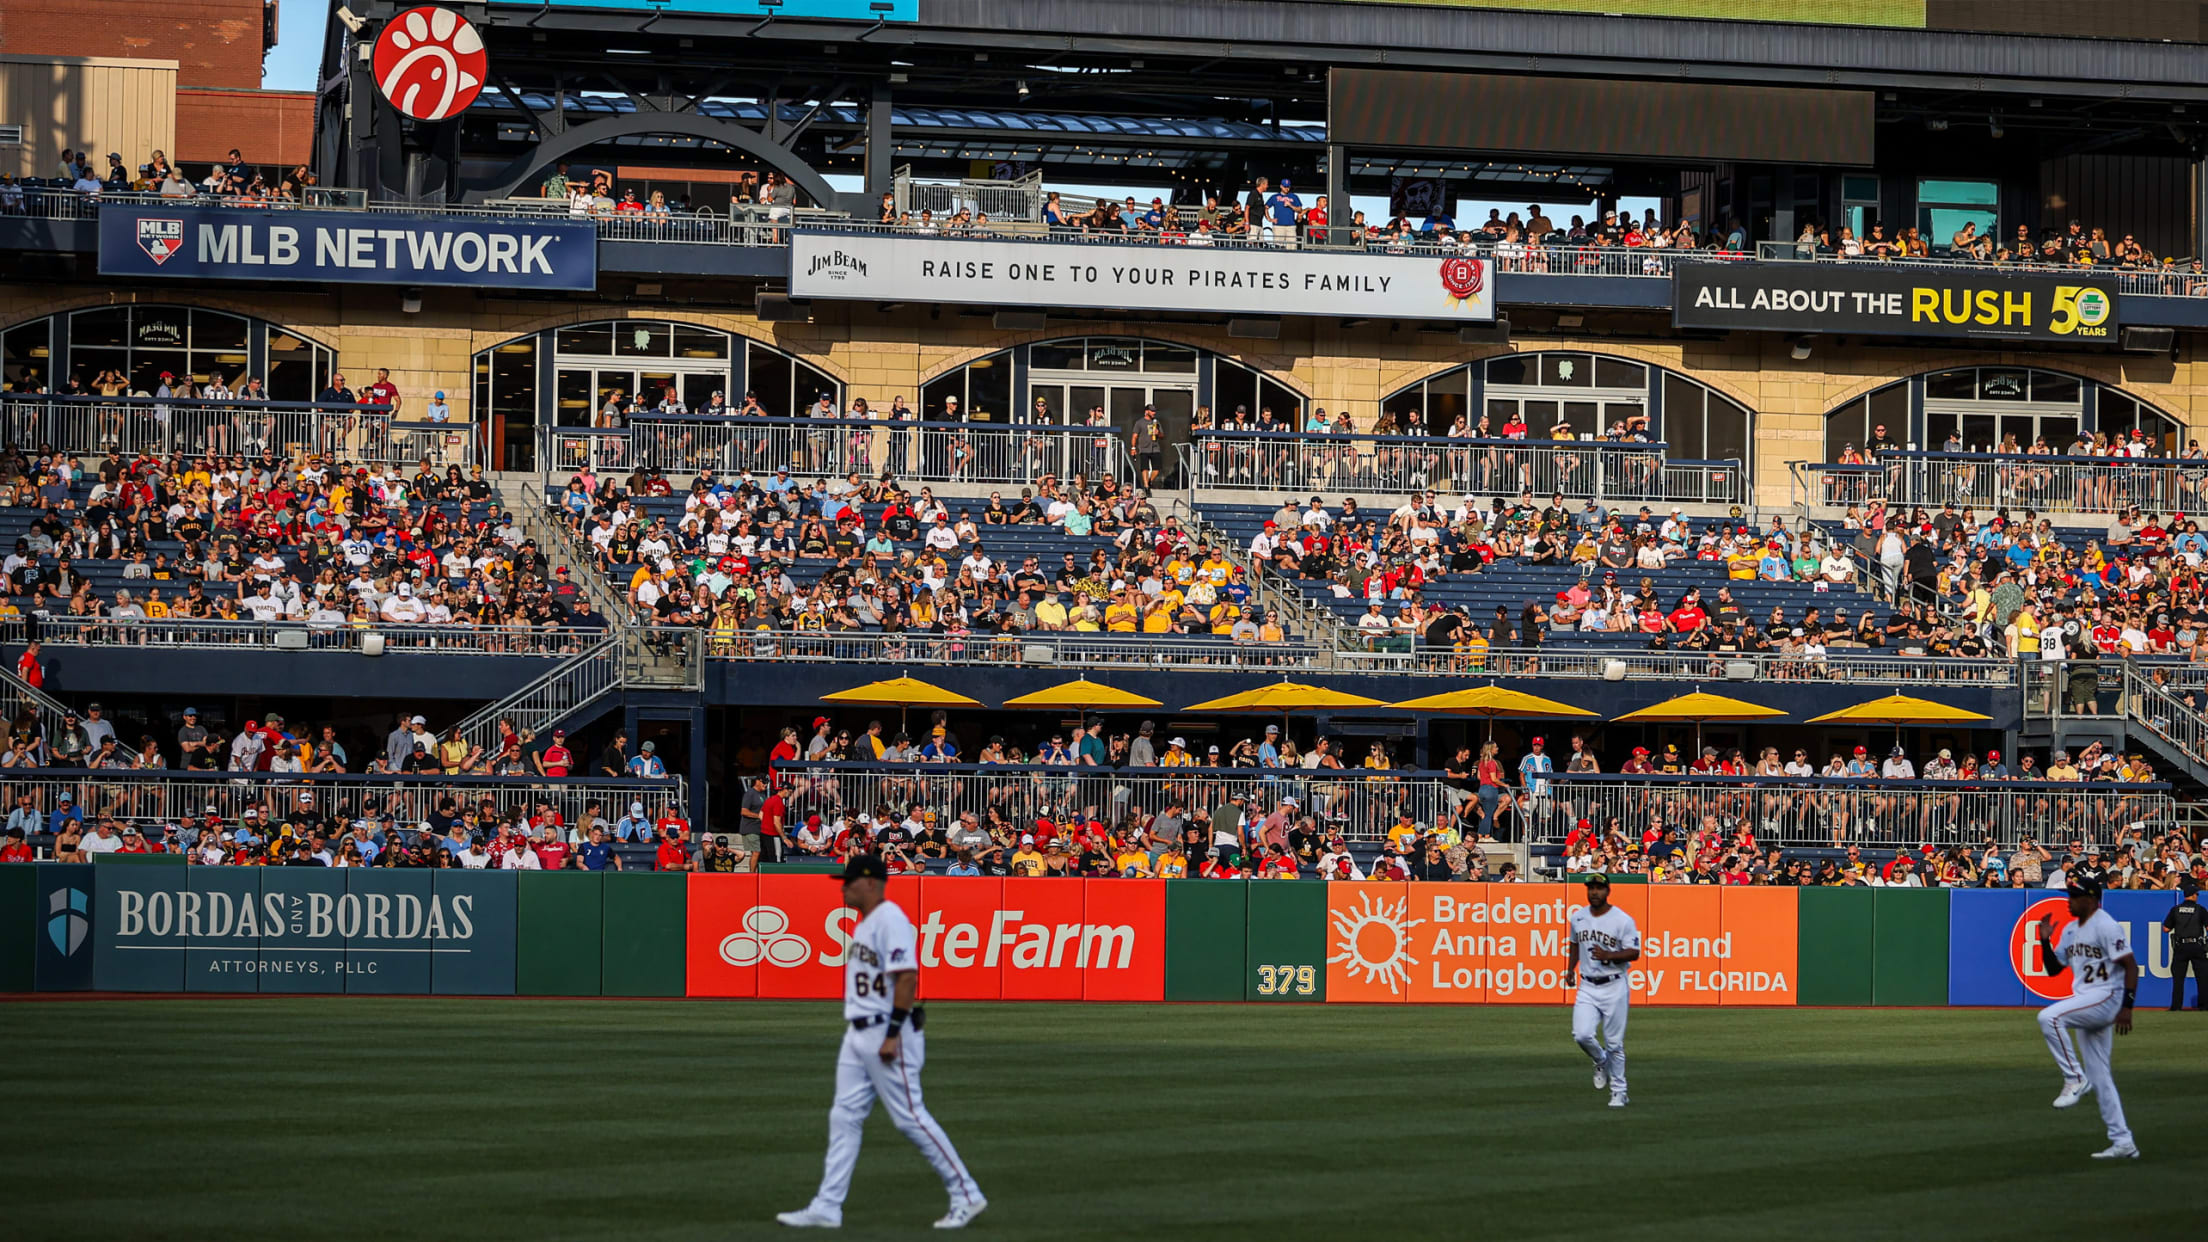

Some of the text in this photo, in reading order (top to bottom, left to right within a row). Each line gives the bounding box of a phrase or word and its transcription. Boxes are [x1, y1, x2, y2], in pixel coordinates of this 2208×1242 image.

[141, 221, 181, 236] MLB
[198, 224, 300, 265] MLB
[834, 250, 868, 278] BEAM
[923, 260, 1391, 293] RAISE ONE TO YOUR PIRATES FAMILY
[1695, 285, 2110, 335] ALL ABOUT THE RUSH 50
[2076, 327, 2107, 336] YEARS
[350, 545, 369, 555] 20
[152, 606, 161, 618] P
[2044, 638, 2056, 651] 38
[117, 891, 474, 939] BORDAS AND BORDAS
[983, 910, 1135, 969] Farm
[1431, 928, 1516, 957] Anna
[209, 961, 377, 975] ATTORNEYS, PLLC
[1257, 965, 1316, 994] 379
[2083, 962, 2108, 983] 24
[856, 972, 886, 998] 64
[1679, 971, 1788, 992] FLORIDA
